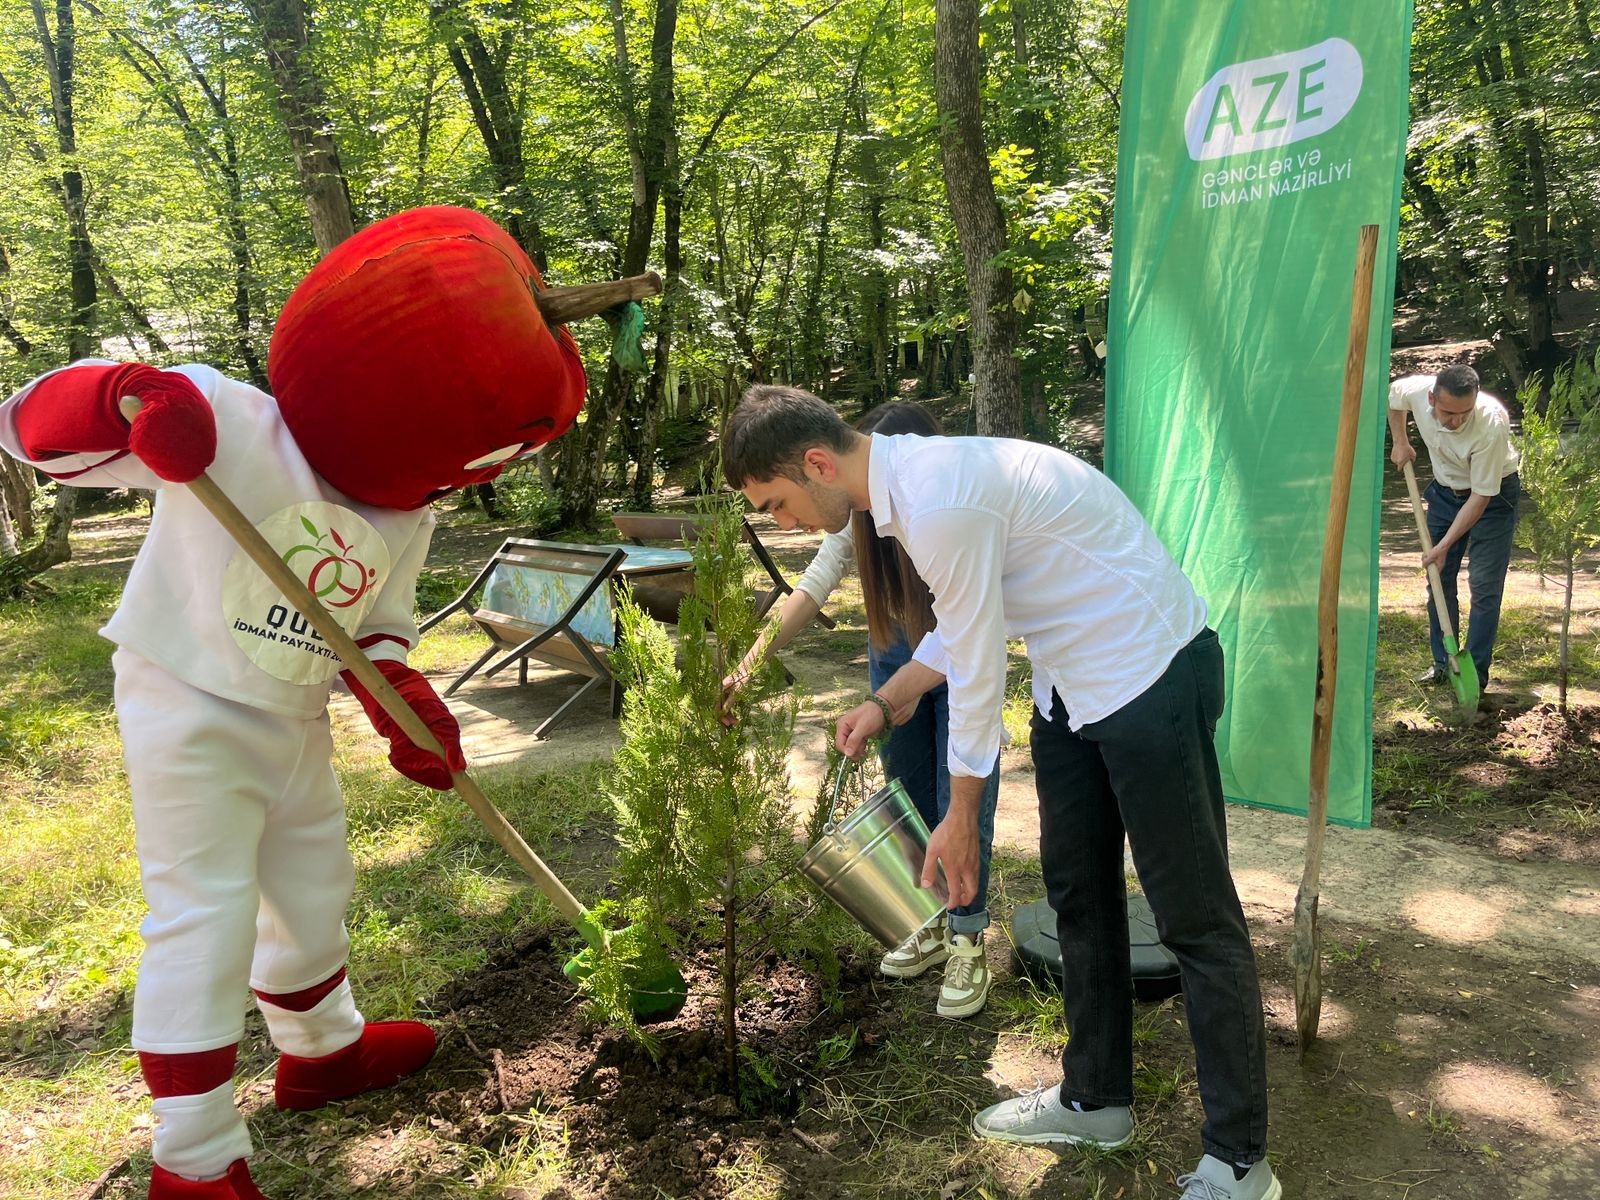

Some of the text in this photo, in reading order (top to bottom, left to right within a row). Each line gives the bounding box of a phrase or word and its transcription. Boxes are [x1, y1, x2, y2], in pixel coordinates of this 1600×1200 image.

[1203, 58, 1327, 144] AZE
[1202, 149, 1321, 189] GƏNCLƏR VƏ
[1202, 158, 1352, 209] İDMAN NAZİRLİYİ
[267, 604, 345, 641] QU
[280, 634, 331, 658] PAYTAXTI
